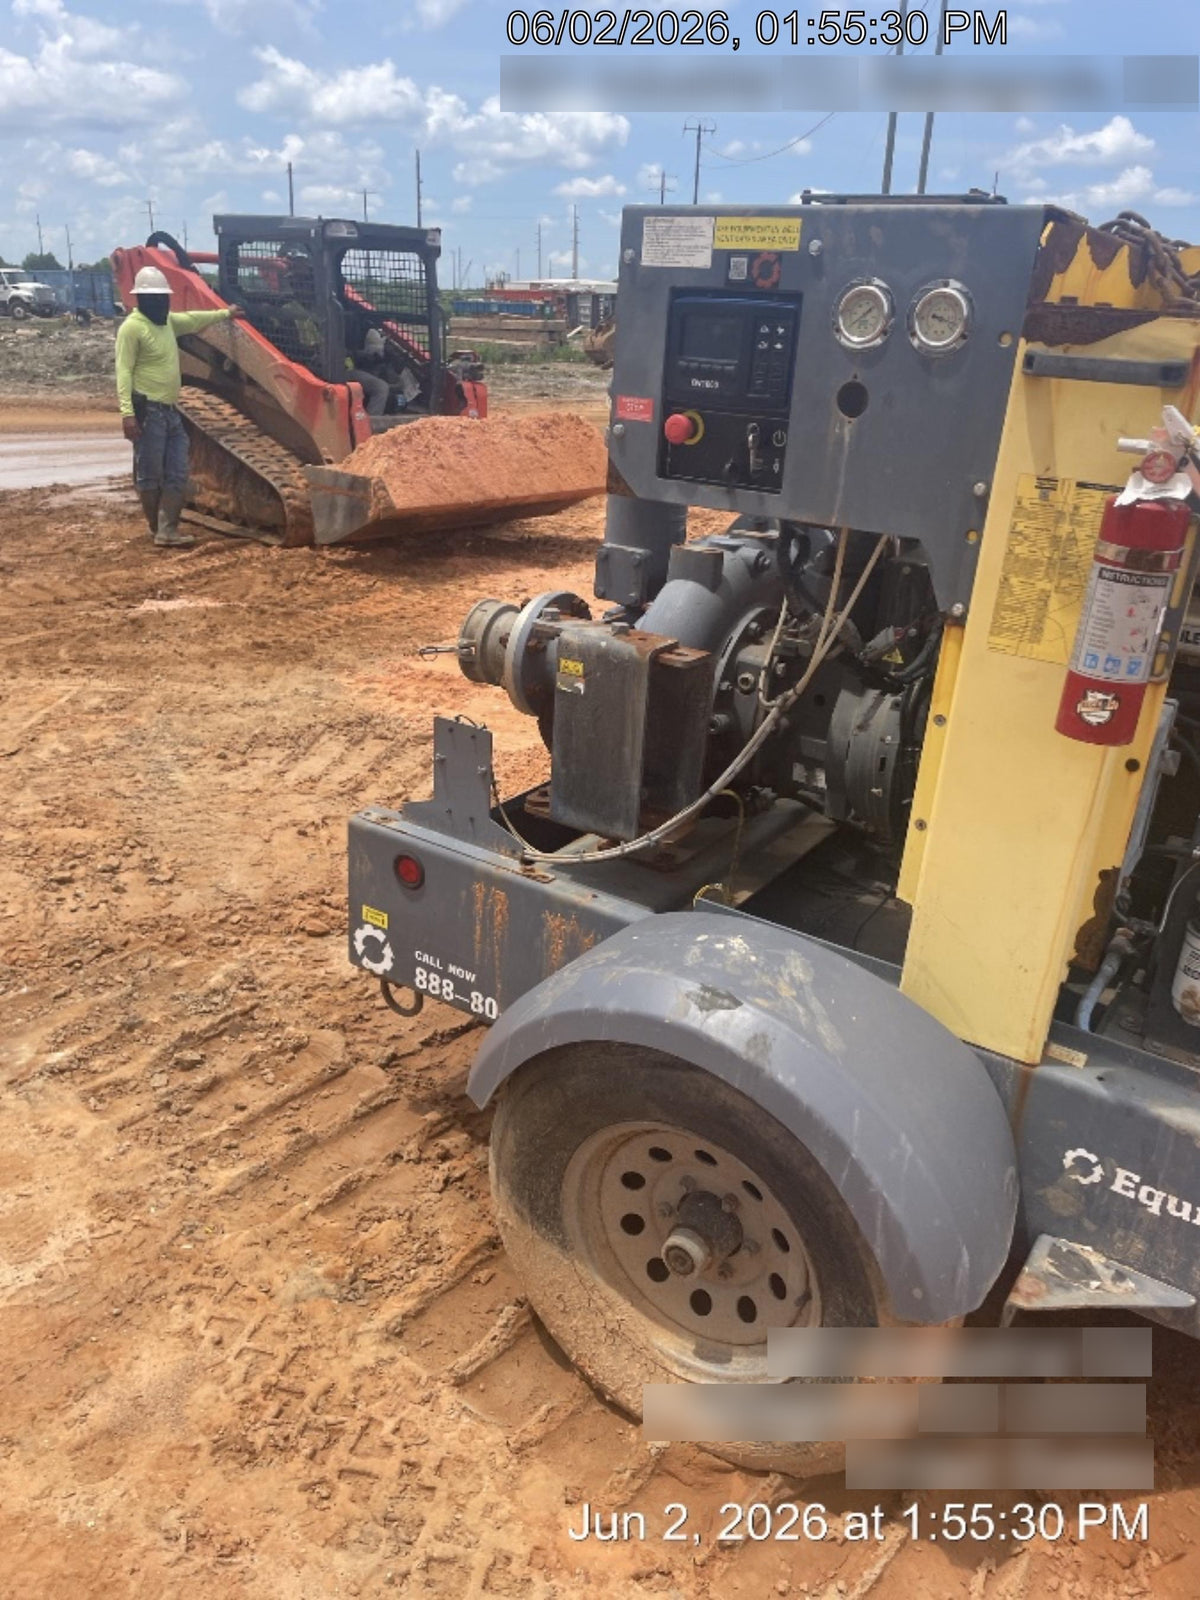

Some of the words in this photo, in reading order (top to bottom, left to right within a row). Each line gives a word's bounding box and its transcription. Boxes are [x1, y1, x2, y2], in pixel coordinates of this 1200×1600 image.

[415, 950, 443, 970] CALL
[447, 963, 476, 983] NOW
[414, 966, 501, 1020] 888-80
